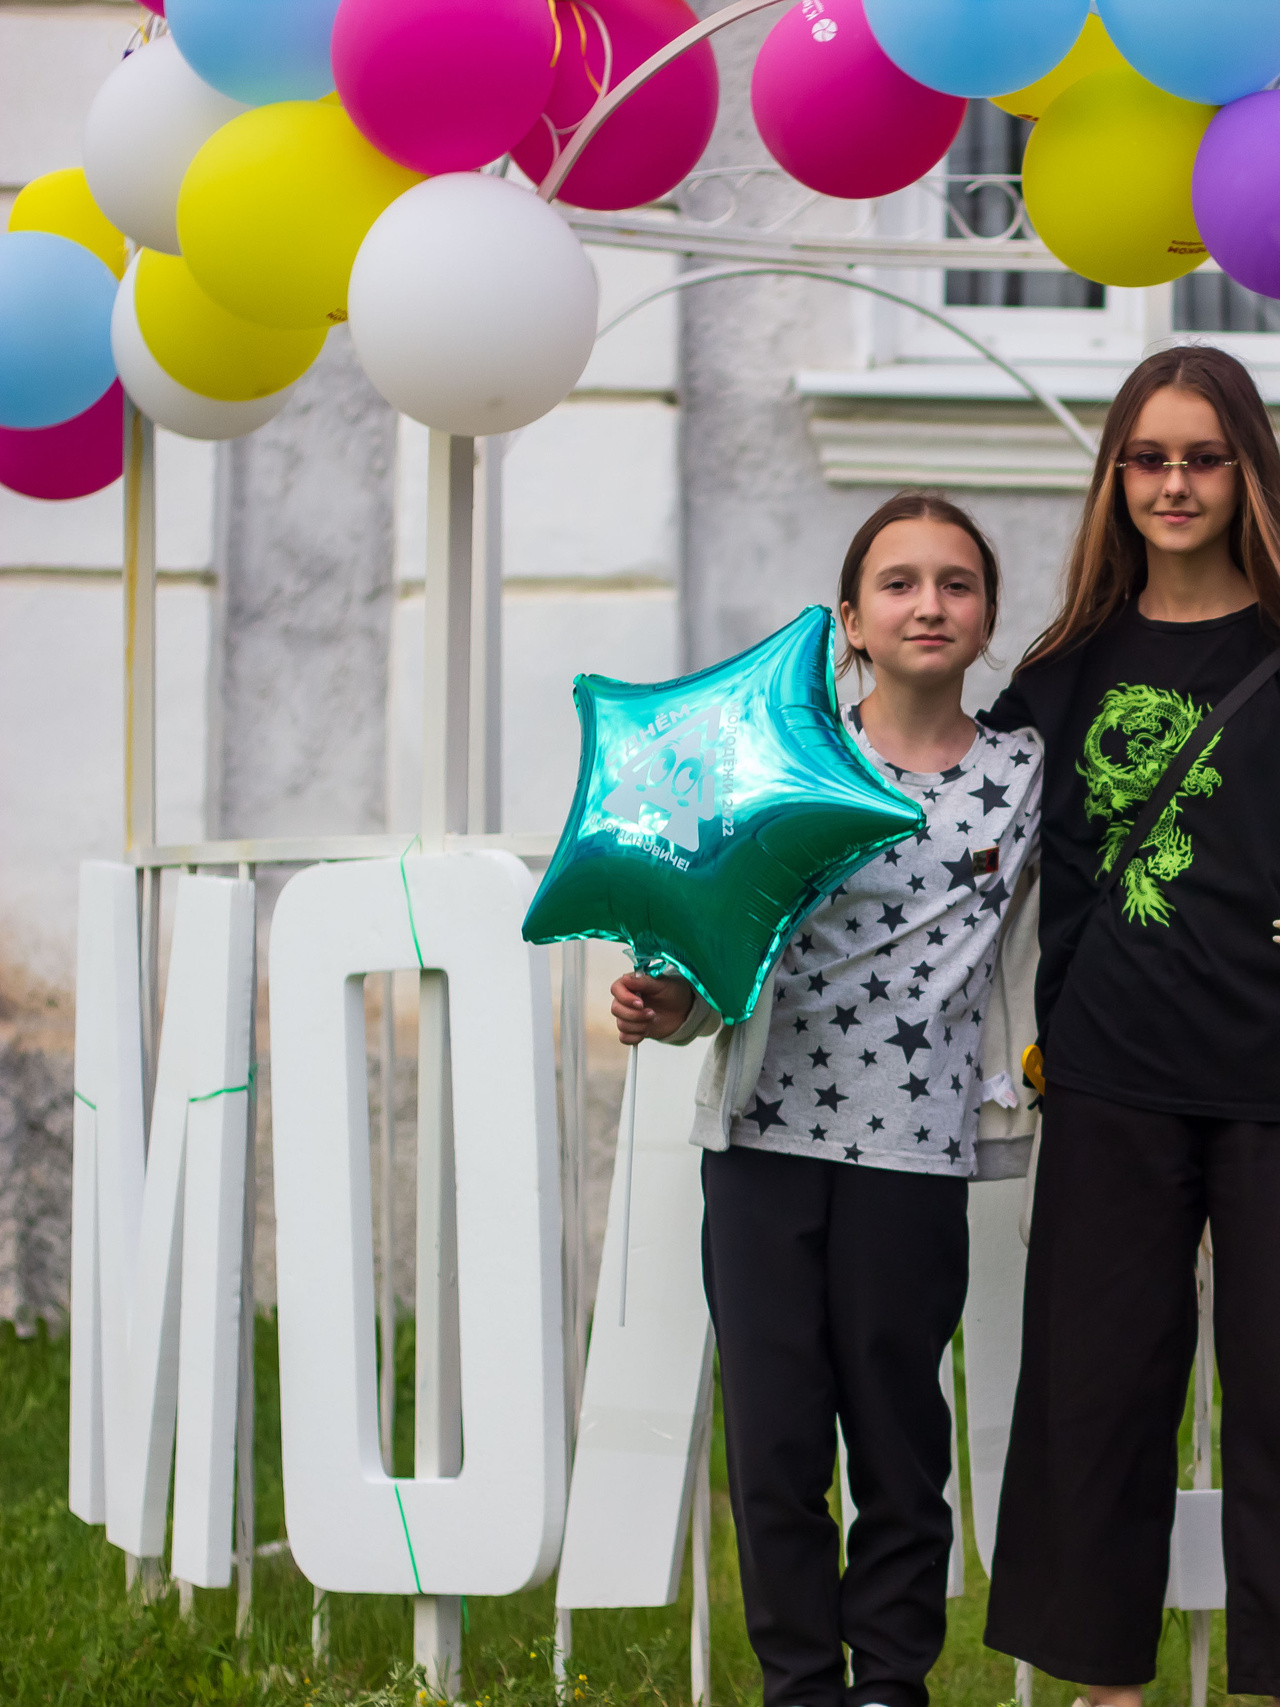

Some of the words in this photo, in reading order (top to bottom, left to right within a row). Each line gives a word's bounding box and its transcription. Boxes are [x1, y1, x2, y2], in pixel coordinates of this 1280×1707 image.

[625, 704, 690, 756] ДНЁМ
[722, 702, 741, 794] МОЛОДЁЖИ
[722, 798, 736, 837] 2022
[599, 817, 690, 872] БОГДАНОВИЧЕ!
